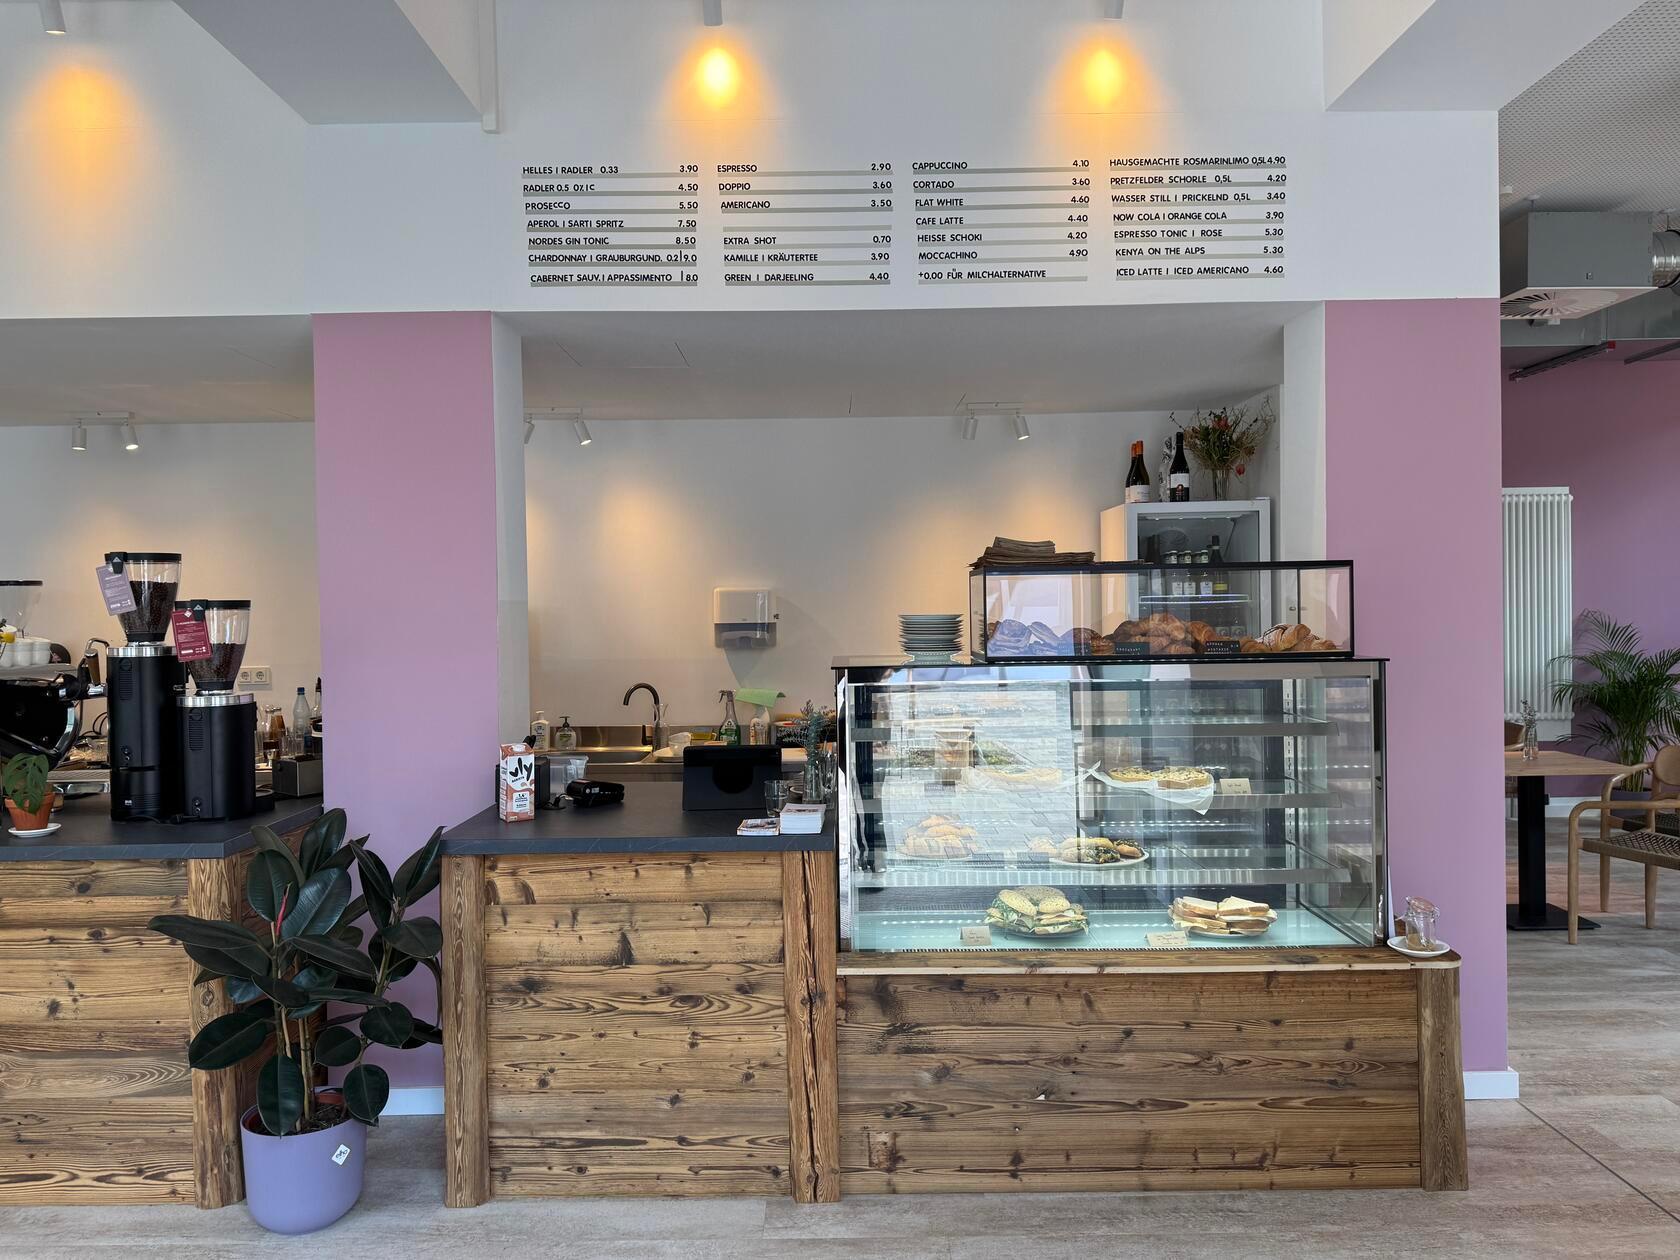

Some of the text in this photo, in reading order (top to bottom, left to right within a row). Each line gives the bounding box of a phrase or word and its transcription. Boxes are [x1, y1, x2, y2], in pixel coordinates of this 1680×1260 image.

[1110, 158, 1179, 166] HAUSGEMACHTE
[1184, 157, 1249, 165] ROSMARINLIMO
[1252, 157, 1266, 166] 0,5L
[600, 166, 618, 174] 0.33
[680, 165, 698, 173] 3.90
[871, 163, 891, 171] 2.90
[912, 162, 967, 170] CAPPUCCINO
[1072, 178, 1090, 186] 3.60
[1111, 177, 1163, 185] PRETZFELDER
[1215, 175, 1232, 183] 0,5L
[1267, 174, 1286, 182] 4.20
[873, 181, 892, 189] 3.60
[1234, 193, 1251, 202] 0,5L
[1267, 192, 1285, 200] 3.40
[525, 202, 570, 210] PROSECCO
[721, 201, 770, 209] AMERICANO
[1205, 212, 1227, 220] COLA
[527, 220, 559, 228] APEROL
[940, 217, 964, 225] LATTE
[1114, 230, 1157, 238] ESPRESSO
[1201, 229, 1223, 237] ROSE
[918, 234, 946, 242] HEISSE
[1069, 249, 1088, 257] 4.90
[1116, 248, 1144, 256] KENYA
[1165, 247, 1180, 255] THE
[1263, 246, 1283, 254] 5.30
[529, 254, 587, 262] CHARDONNAY
[596, 254, 663, 262] GRAUBURGUND.
[684, 254, 697, 262] 9.0
[768, 253, 818, 261] KRÄUTERTEE
[947, 269, 962, 279] FÜR
[967, 270, 1046, 278] MILCHALTERNATIVE
[1116, 268, 1135, 276] ICED
[1174, 267, 1193, 275] ICED
[1197, 267, 1249, 275] AMERICANO
[1264, 266, 1283, 274] 4.60
[531, 274, 573, 282] CABERNET
[577, 274, 601, 282] SAUV.
[686, 274, 698, 282] 8.0
[725, 274, 751, 282] GREEN
